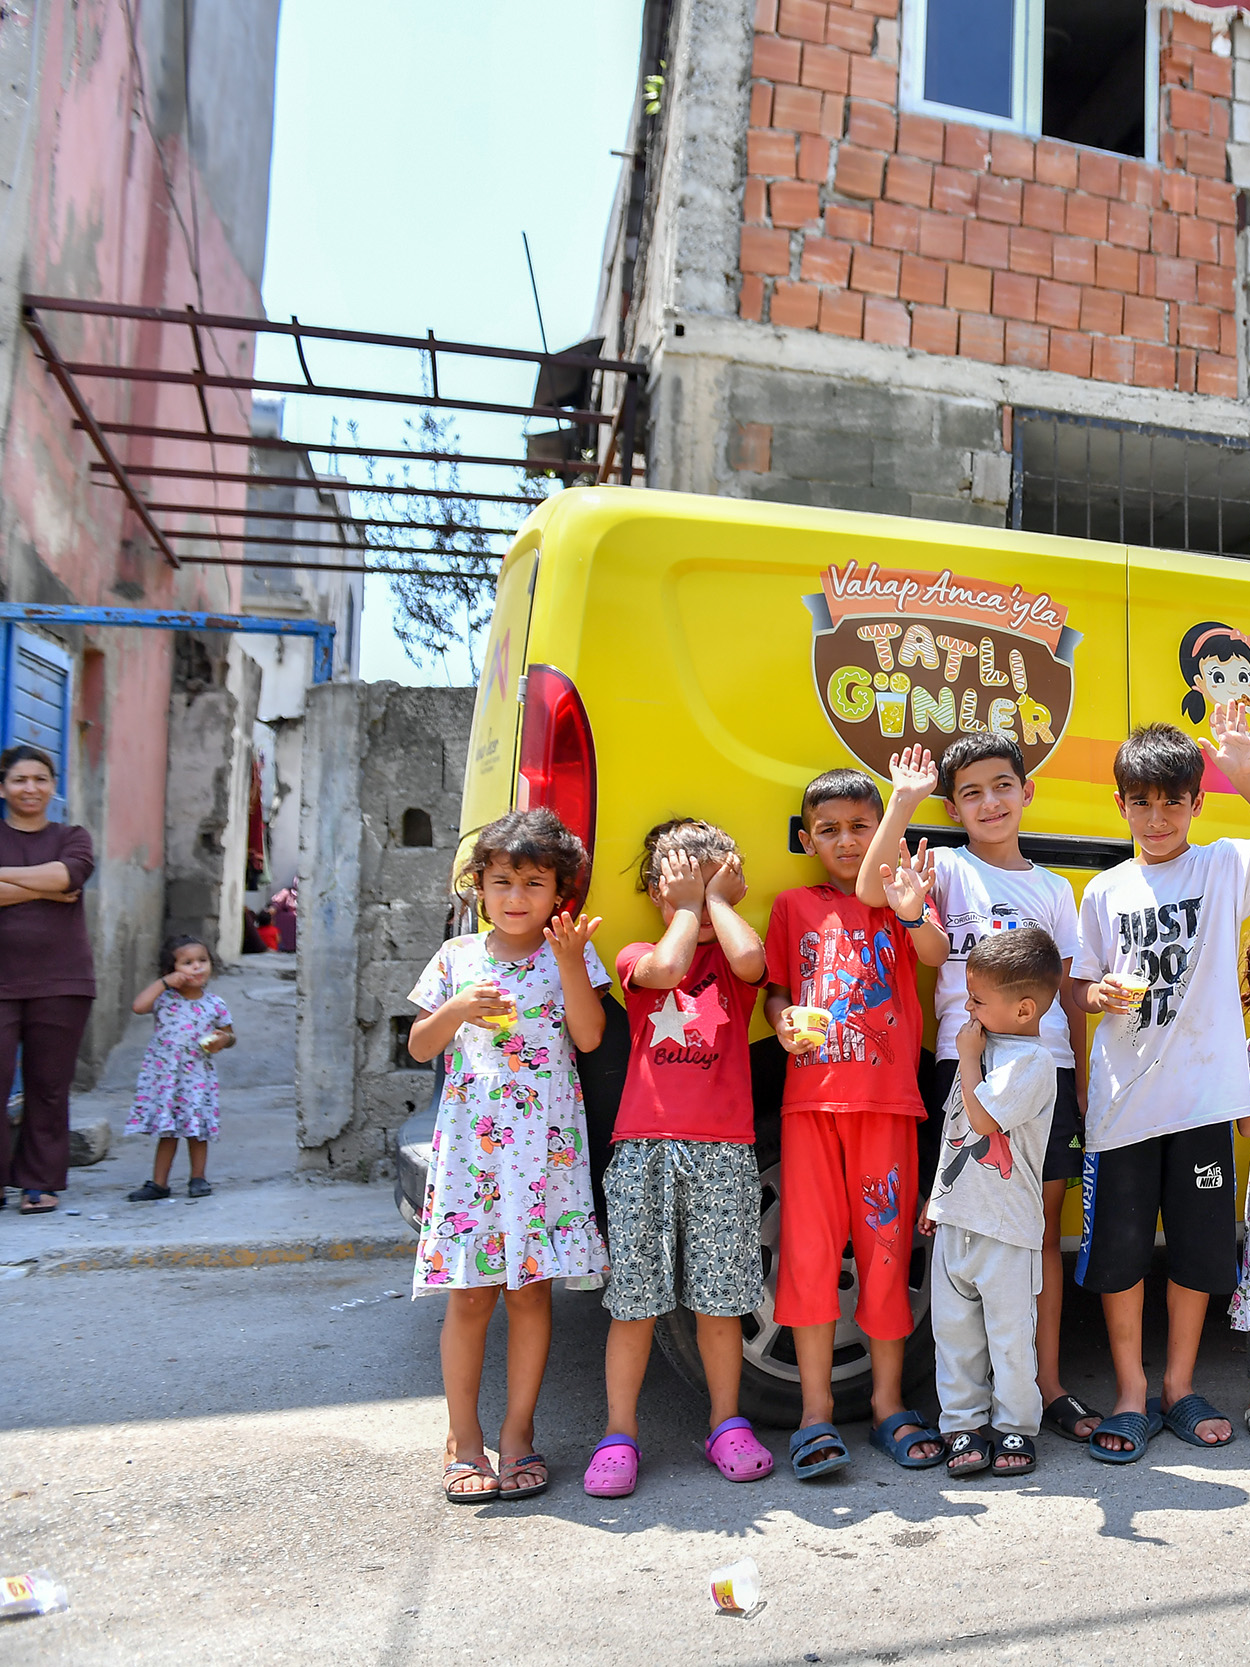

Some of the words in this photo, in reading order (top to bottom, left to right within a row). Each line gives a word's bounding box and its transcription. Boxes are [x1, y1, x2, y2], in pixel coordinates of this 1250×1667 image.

[830, 560, 918, 611] Vahap
[922, 570, 1060, 629] Amca'yla
[857, 622, 1028, 693] TATLI
[827, 665, 1056, 745] GÜNLER
[1117, 895, 1204, 955] JUST
[1136, 944, 1188, 987] DO
[1199, 1177, 1220, 1188] NIKE
[1206, 1166, 1222, 1177] AIR
